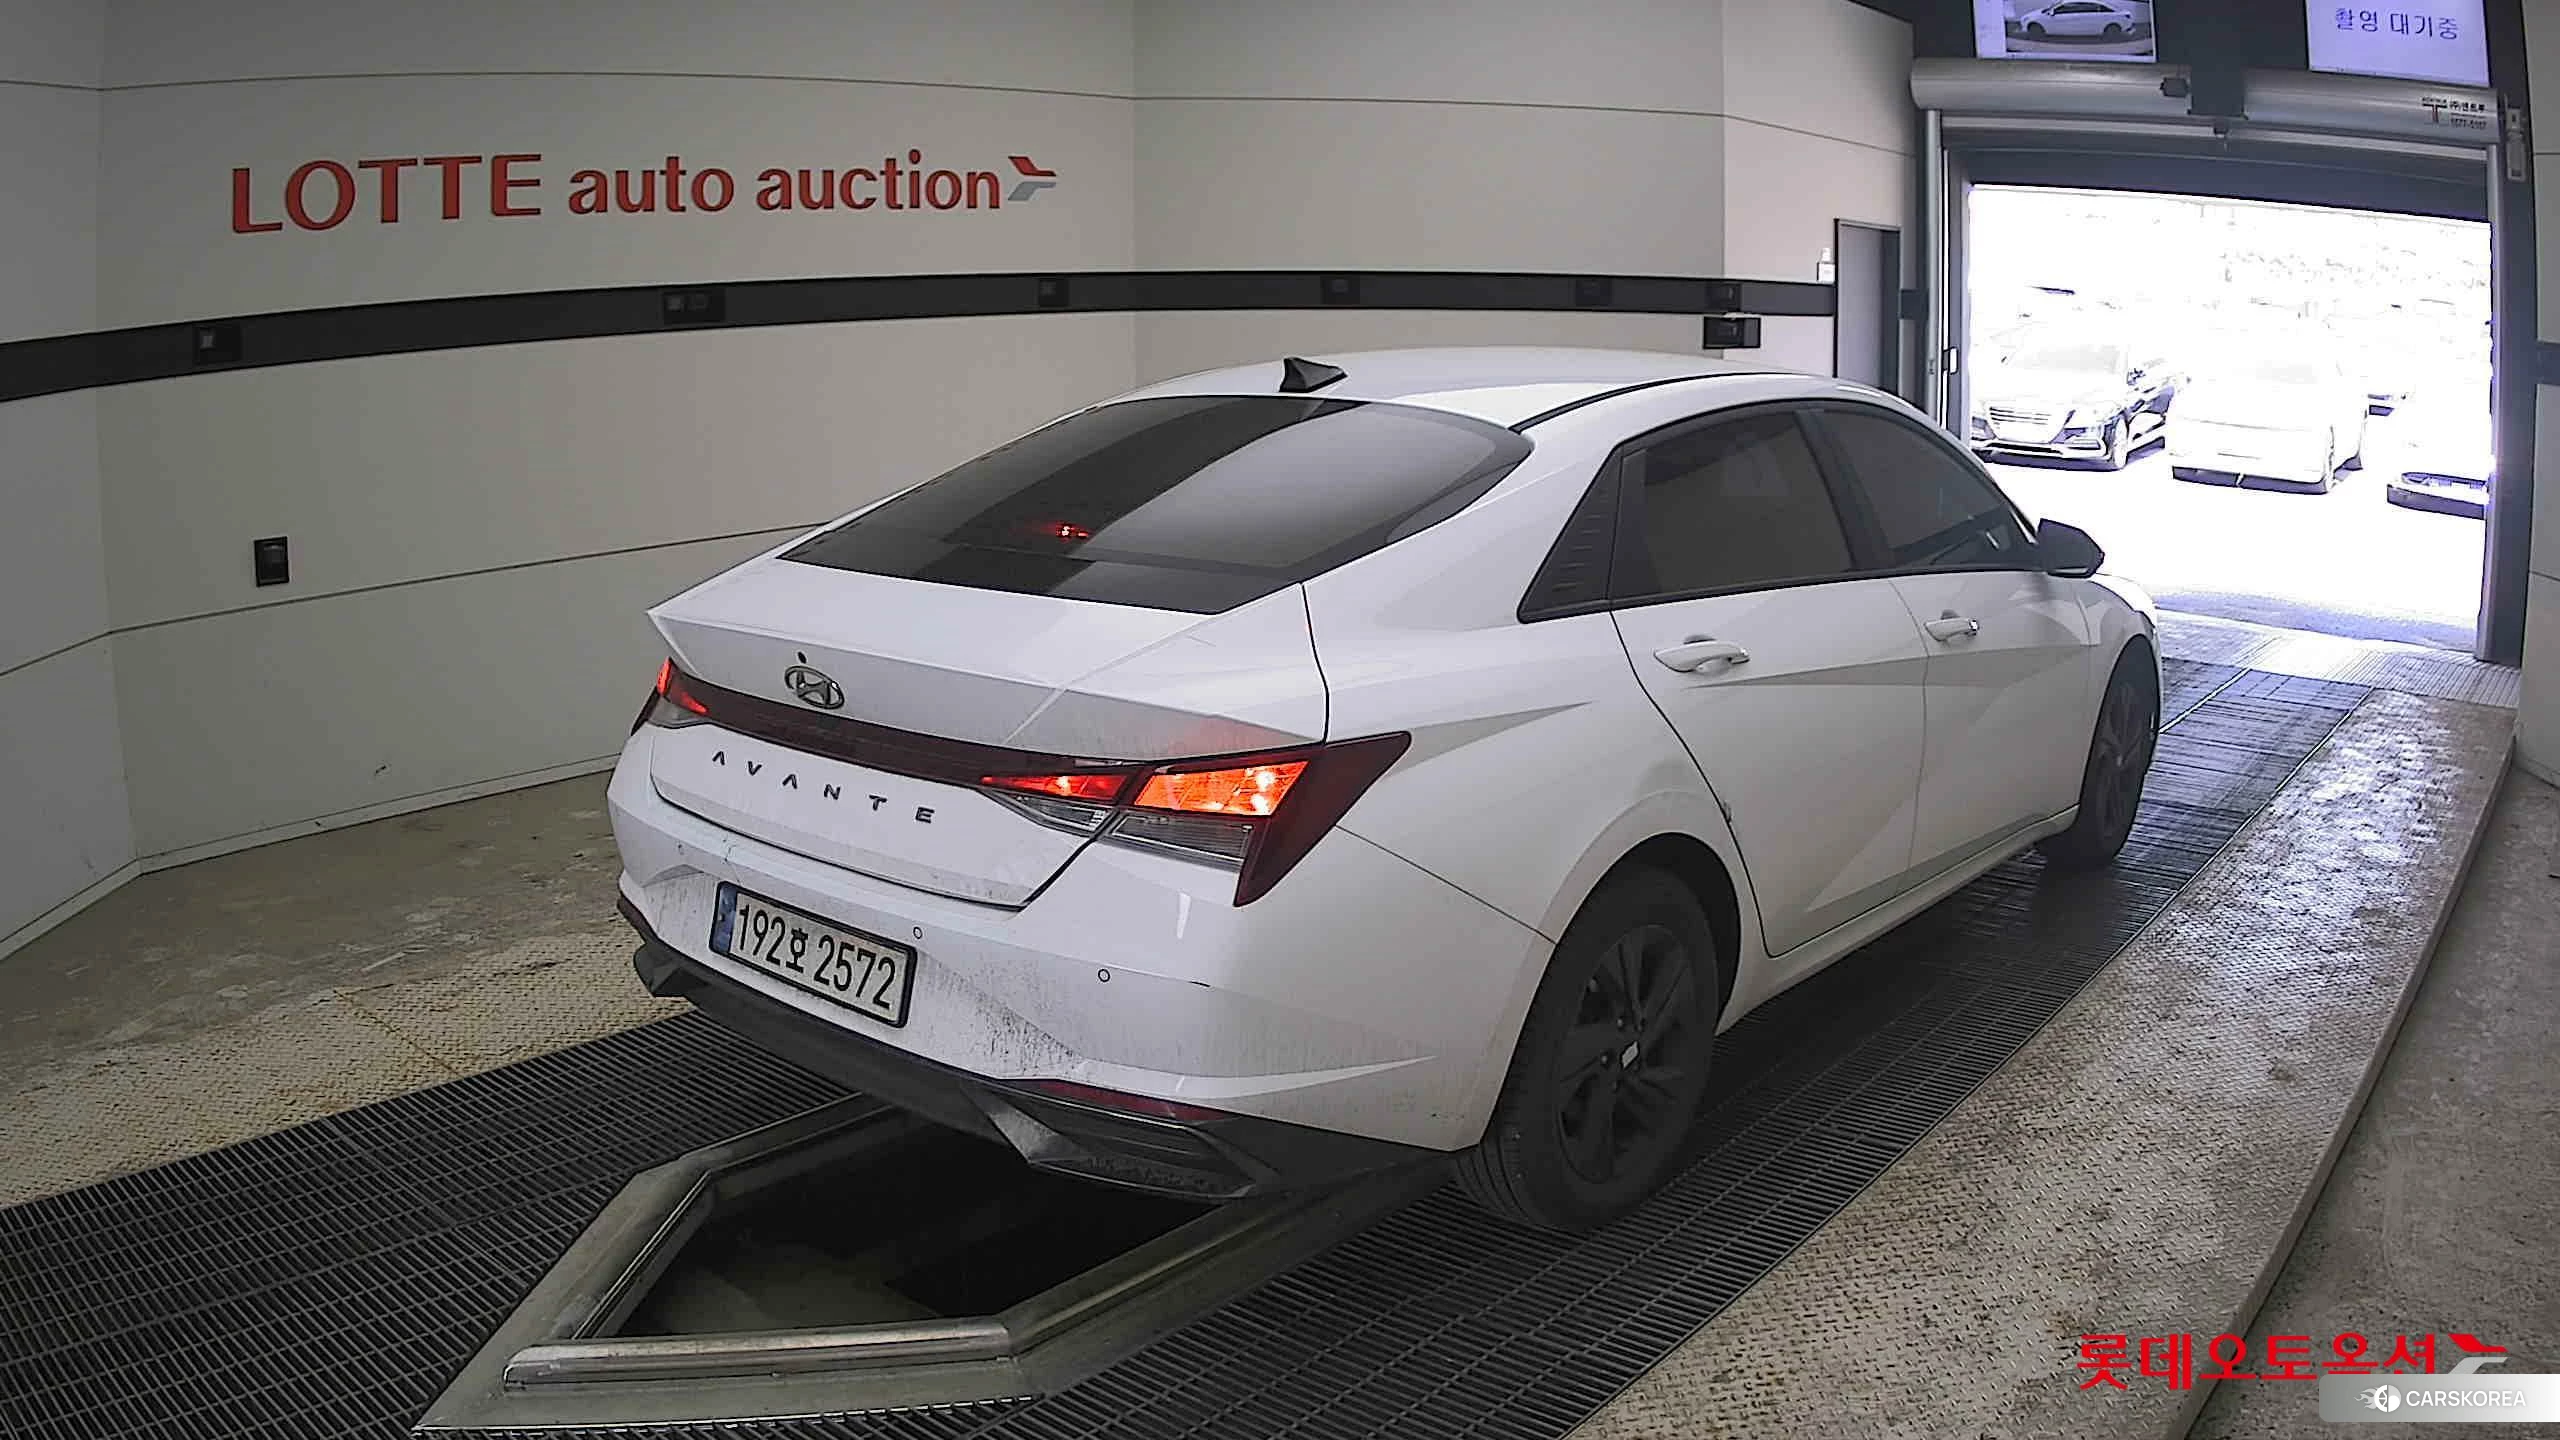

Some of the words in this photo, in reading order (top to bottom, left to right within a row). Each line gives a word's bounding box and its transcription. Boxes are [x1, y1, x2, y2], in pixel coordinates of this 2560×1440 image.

[2390, 12, 2458, 41] 대기중
[232, 153, 542, 234] LOTTE
[568, 155, 735, 215] auto
[756, 148, 1001, 212] auction
[711, 750, 936, 824] AVANTE
[813, 934, 897, 1011] 2572
